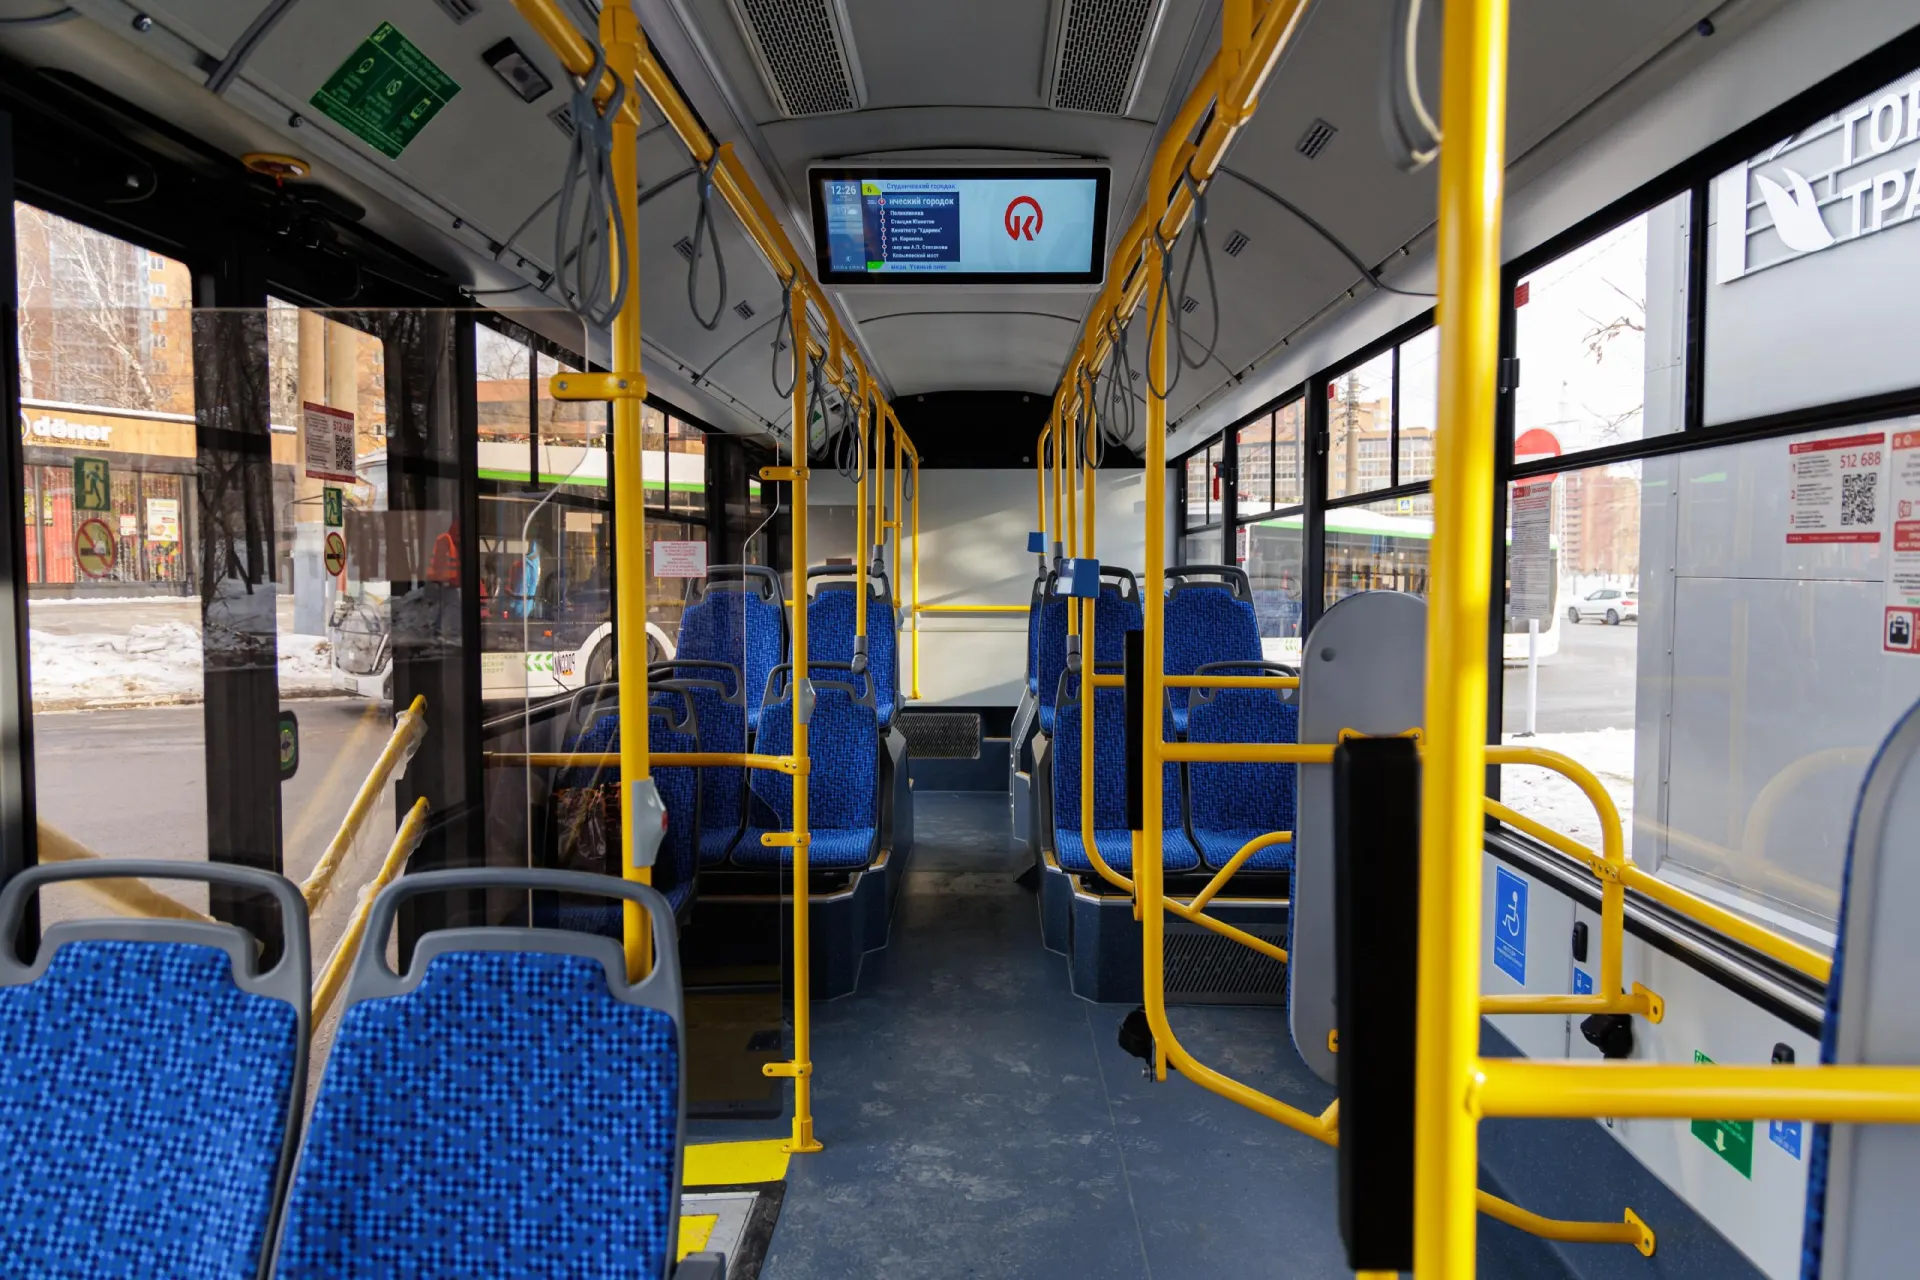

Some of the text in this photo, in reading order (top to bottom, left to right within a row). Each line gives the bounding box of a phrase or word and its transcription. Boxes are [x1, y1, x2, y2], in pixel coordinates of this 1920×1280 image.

[831, 185, 856, 195] 12:26
[923, 198, 954, 207] городок
[1840, 453, 1857, 469] 512
[1861, 451, 1881, 467] 688
